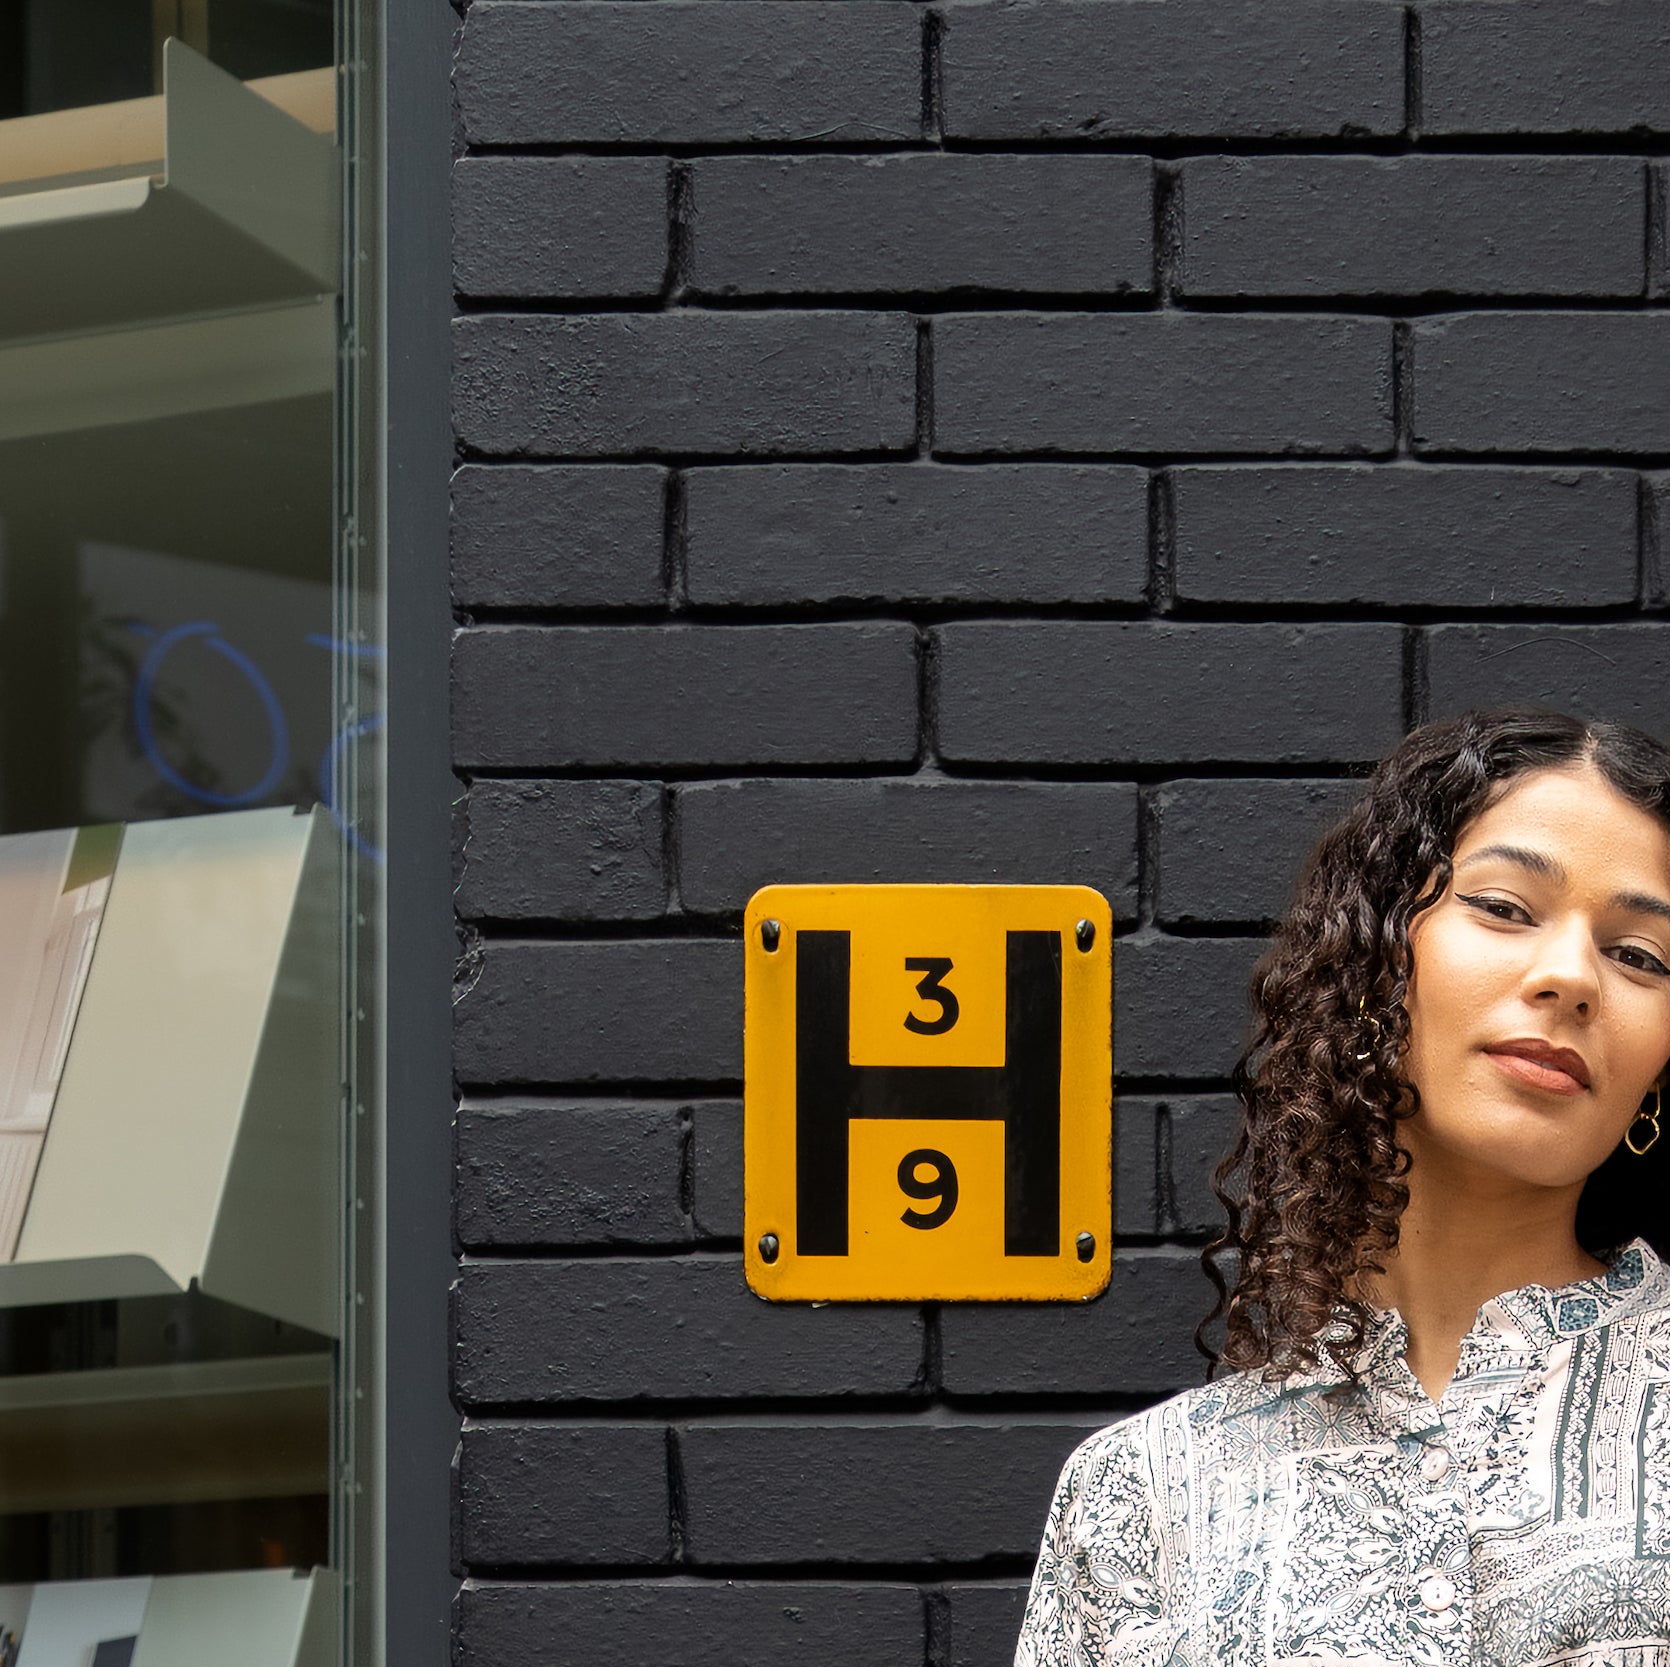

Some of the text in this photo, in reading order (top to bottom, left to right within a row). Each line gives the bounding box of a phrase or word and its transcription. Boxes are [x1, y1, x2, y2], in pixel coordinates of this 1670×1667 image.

[903, 957, 960, 1035] 3
[796, 930, 1061, 1256] H
[897, 1149, 959, 1230] 9
